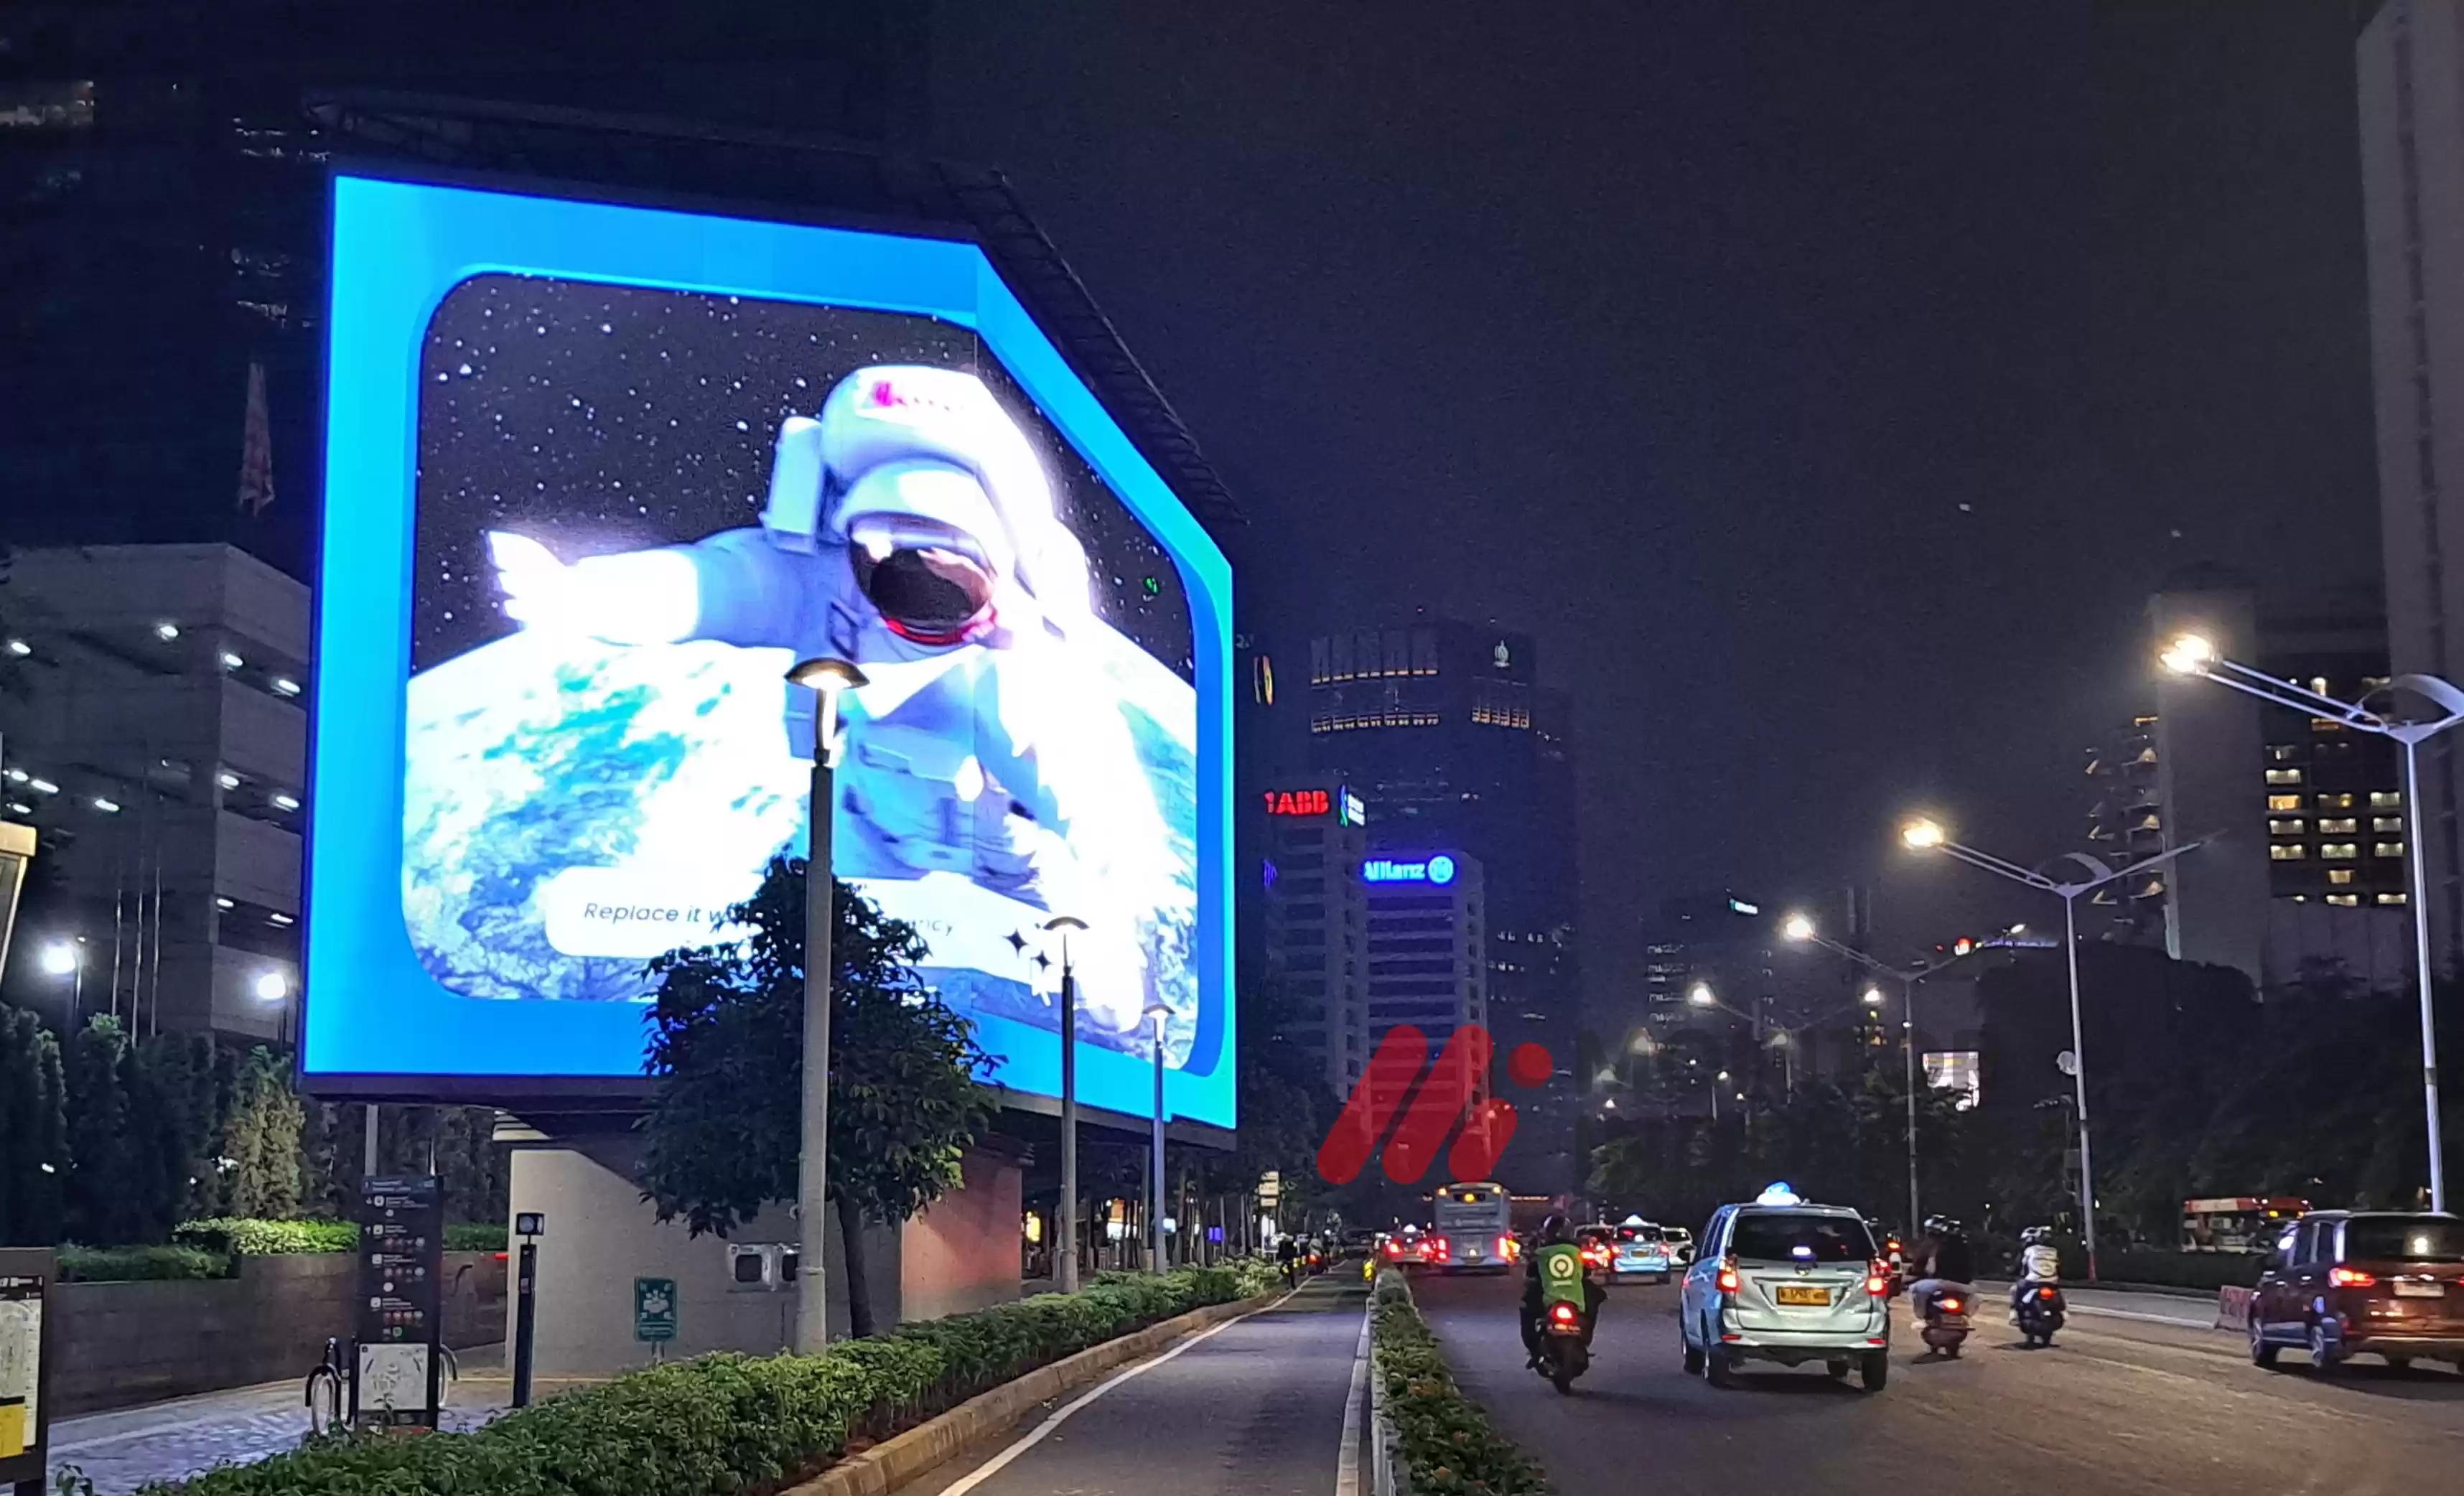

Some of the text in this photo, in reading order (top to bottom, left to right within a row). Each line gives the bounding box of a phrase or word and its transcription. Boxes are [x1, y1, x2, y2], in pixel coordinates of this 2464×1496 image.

[1276, 790, 1328, 815] ABB
[584, 902, 680, 925] Replace
[686, 905, 701, 922] it
